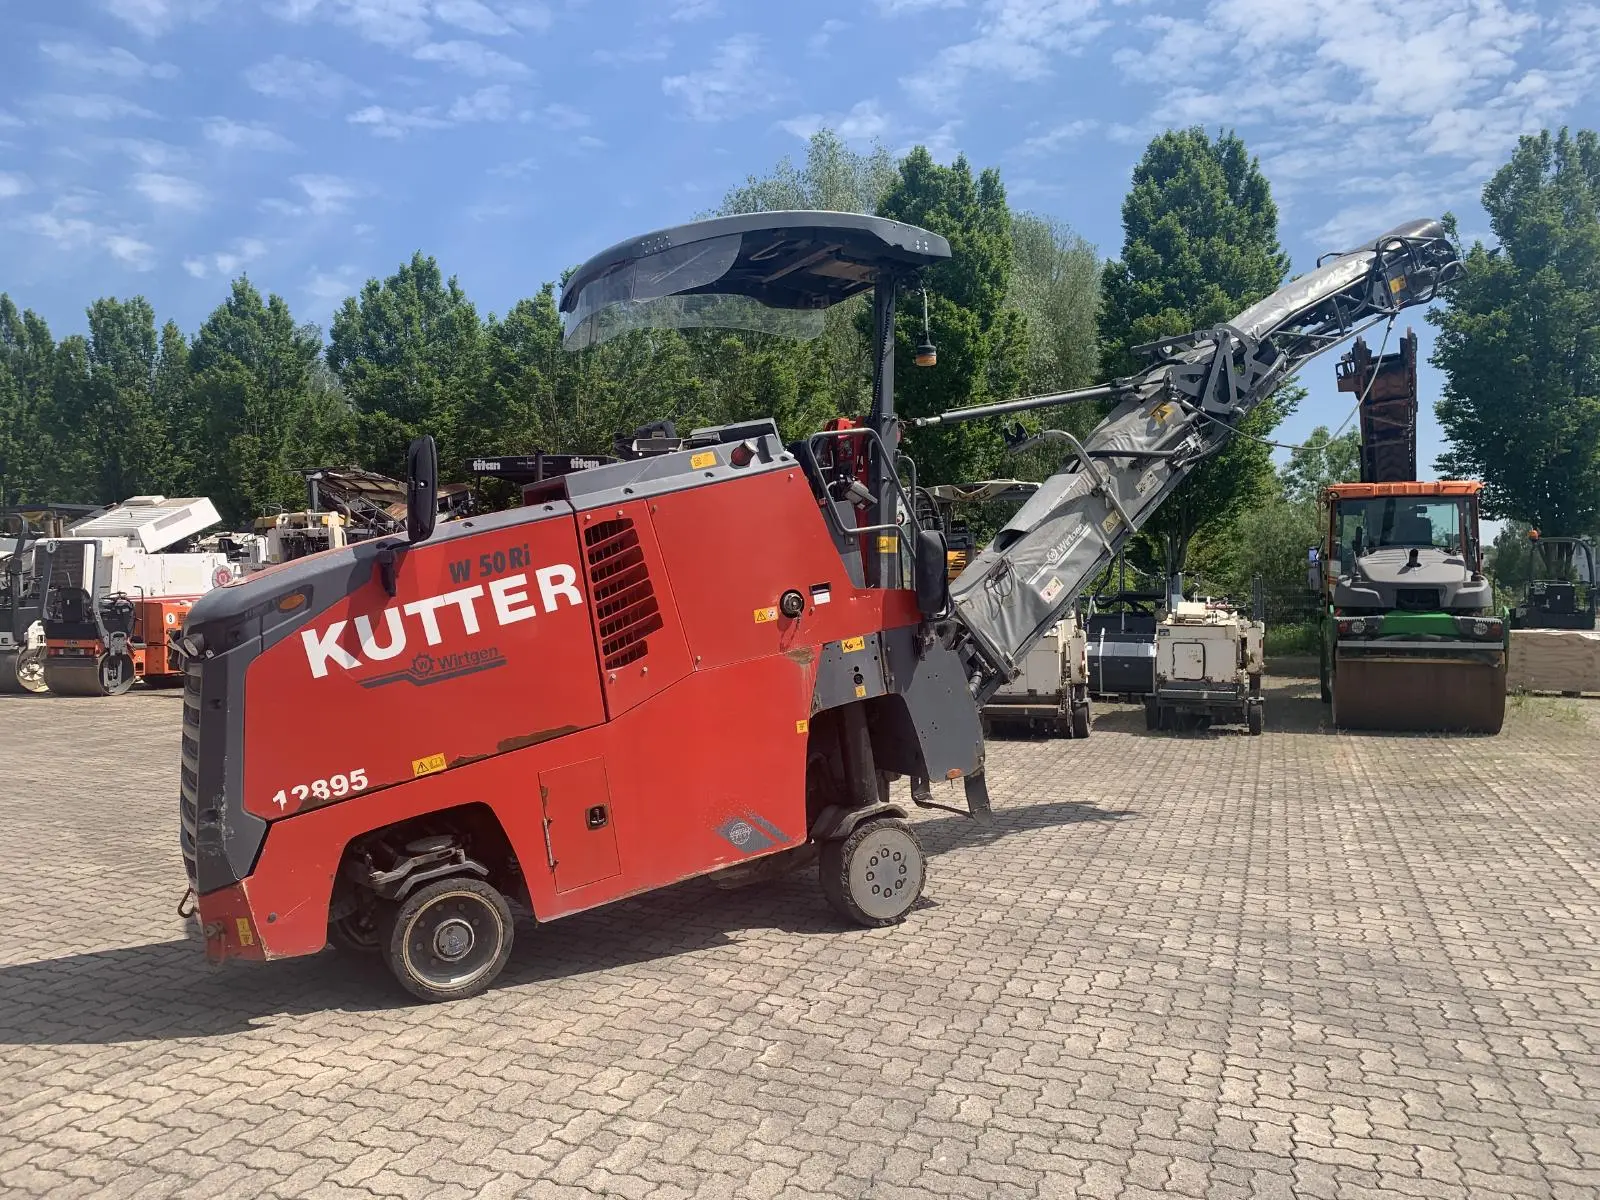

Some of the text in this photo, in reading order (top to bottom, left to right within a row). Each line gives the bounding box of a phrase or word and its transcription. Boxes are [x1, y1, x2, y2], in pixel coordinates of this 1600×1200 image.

[473, 460, 500, 471] titan
[570, 457, 599, 469] titan
[449, 543, 531, 584] W 50 Ri
[301, 563, 583, 679] KUTTER
[437, 646, 498, 670] Wirtgen
